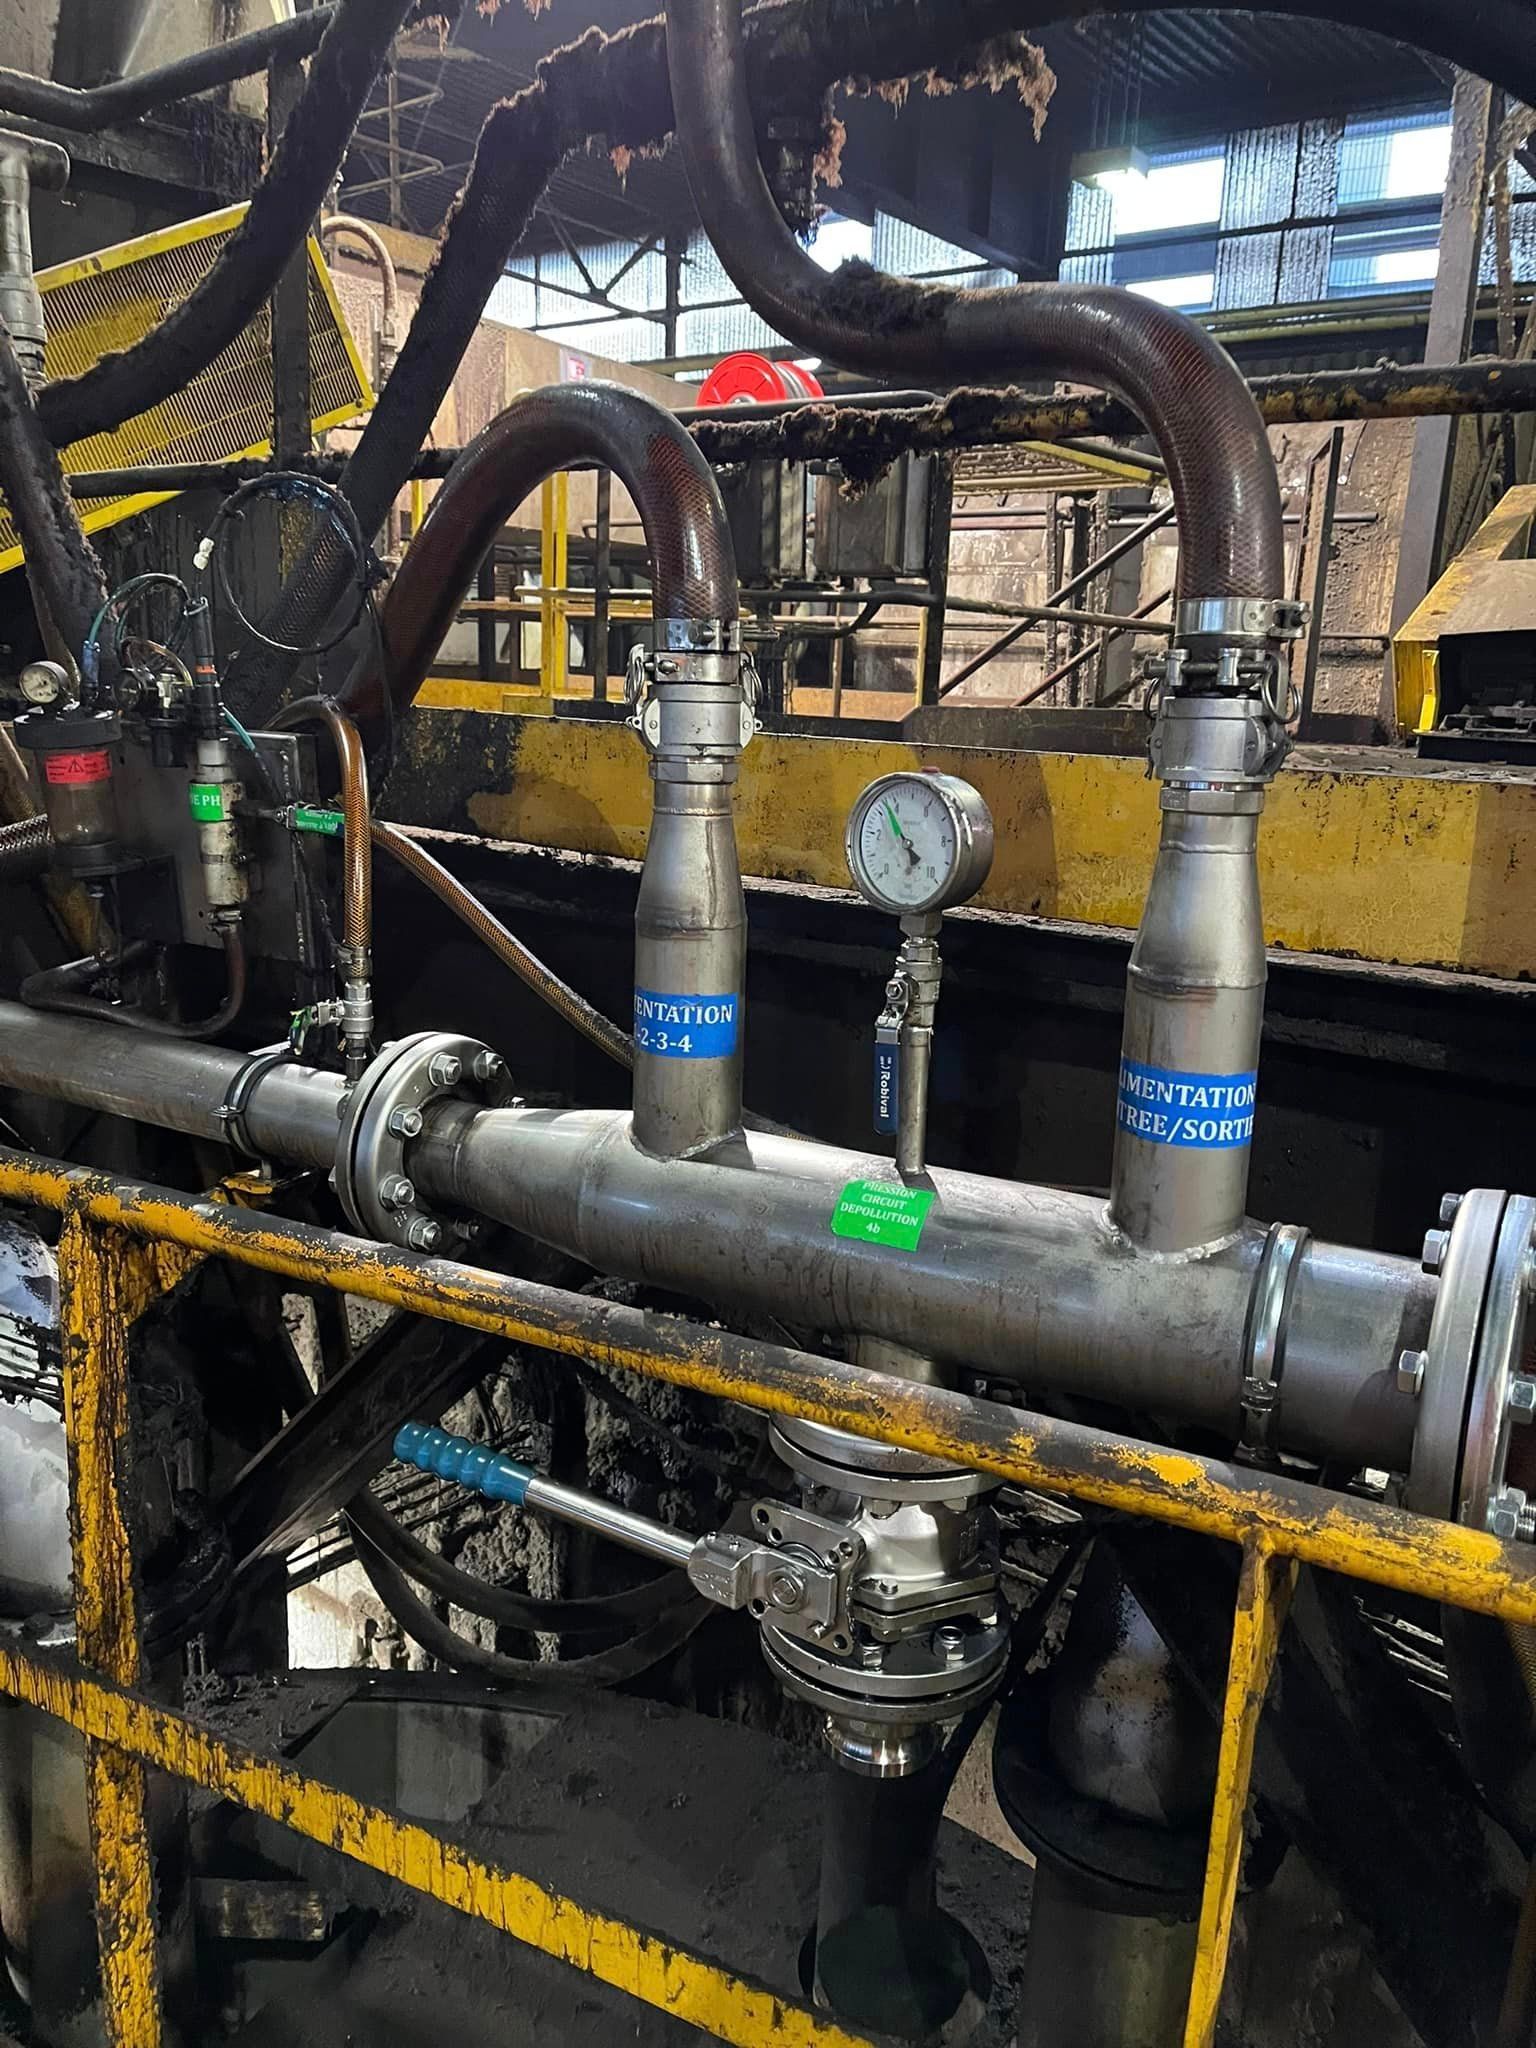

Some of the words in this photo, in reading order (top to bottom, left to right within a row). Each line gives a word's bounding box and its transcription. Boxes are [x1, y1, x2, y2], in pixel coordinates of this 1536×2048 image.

[202, 794, 221, 806] PH
[927, 866, 936, 878] 10
[880, 1071, 891, 1118] Robival
[862, 1181, 917, 1200] PRESSION
[861, 1193, 908, 1210] CIRCUIT
[840, 1202, 919, 1227] DEPOLLUTION
[865, 1222, 881, 1234] 4b
